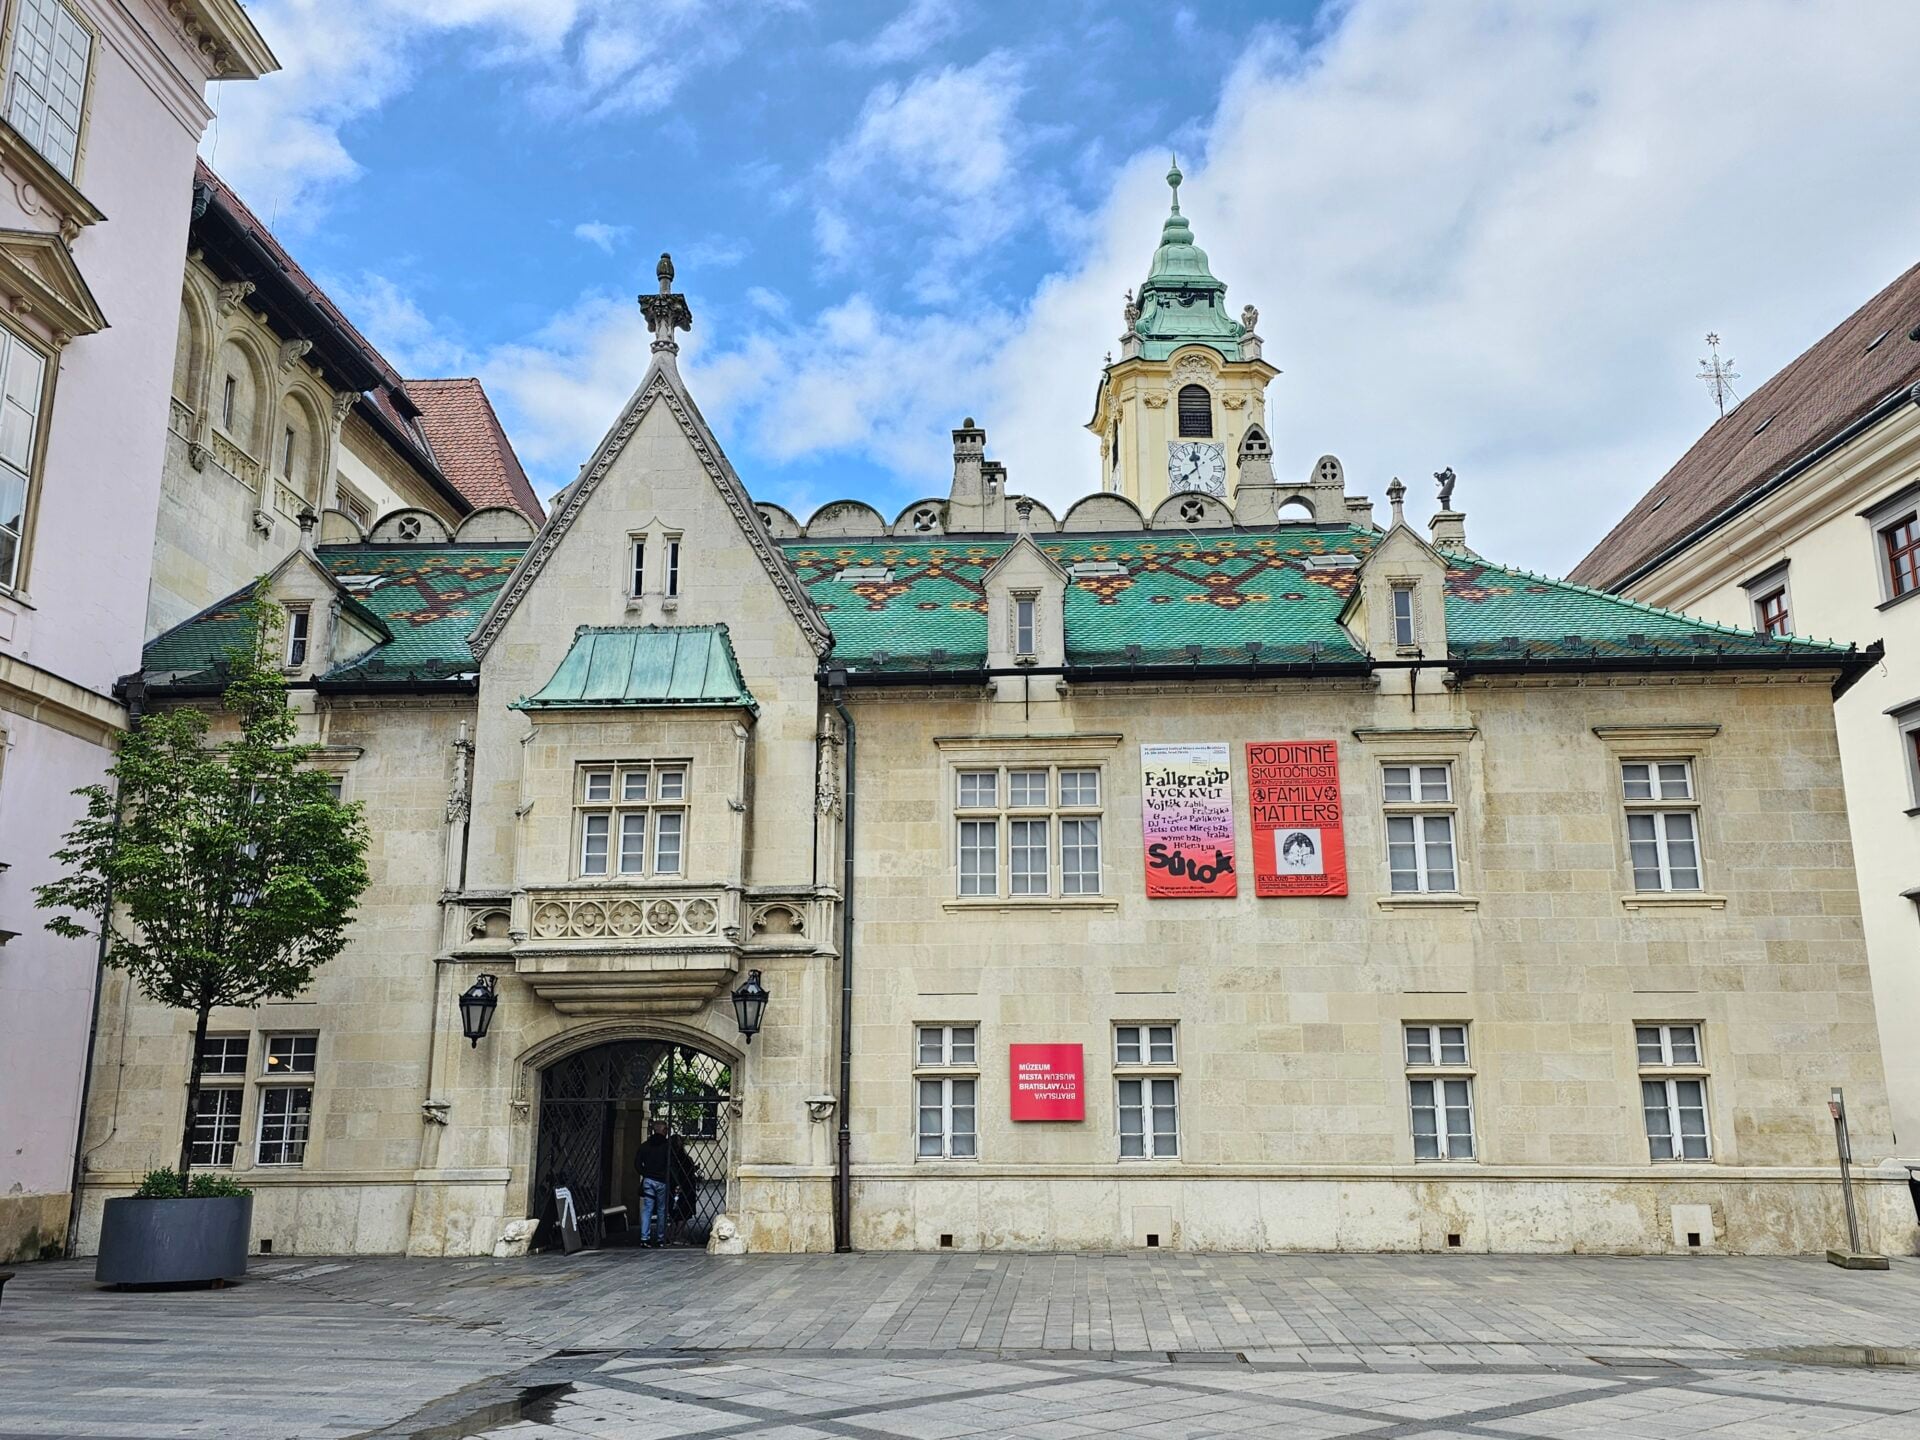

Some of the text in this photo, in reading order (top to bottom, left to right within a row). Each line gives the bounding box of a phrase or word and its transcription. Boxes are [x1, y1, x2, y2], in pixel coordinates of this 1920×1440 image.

[1250, 744, 1334, 764] RODINNÉ
[1252, 765, 1336, 778] SKUTOČNOSTI
[1150, 788, 1186, 798] FVCK
[1268, 787, 1323, 802] FAMILY
[1254, 804, 1339, 822] MATTERS
[1019, 1063, 1050, 1071] MÚZEUM
